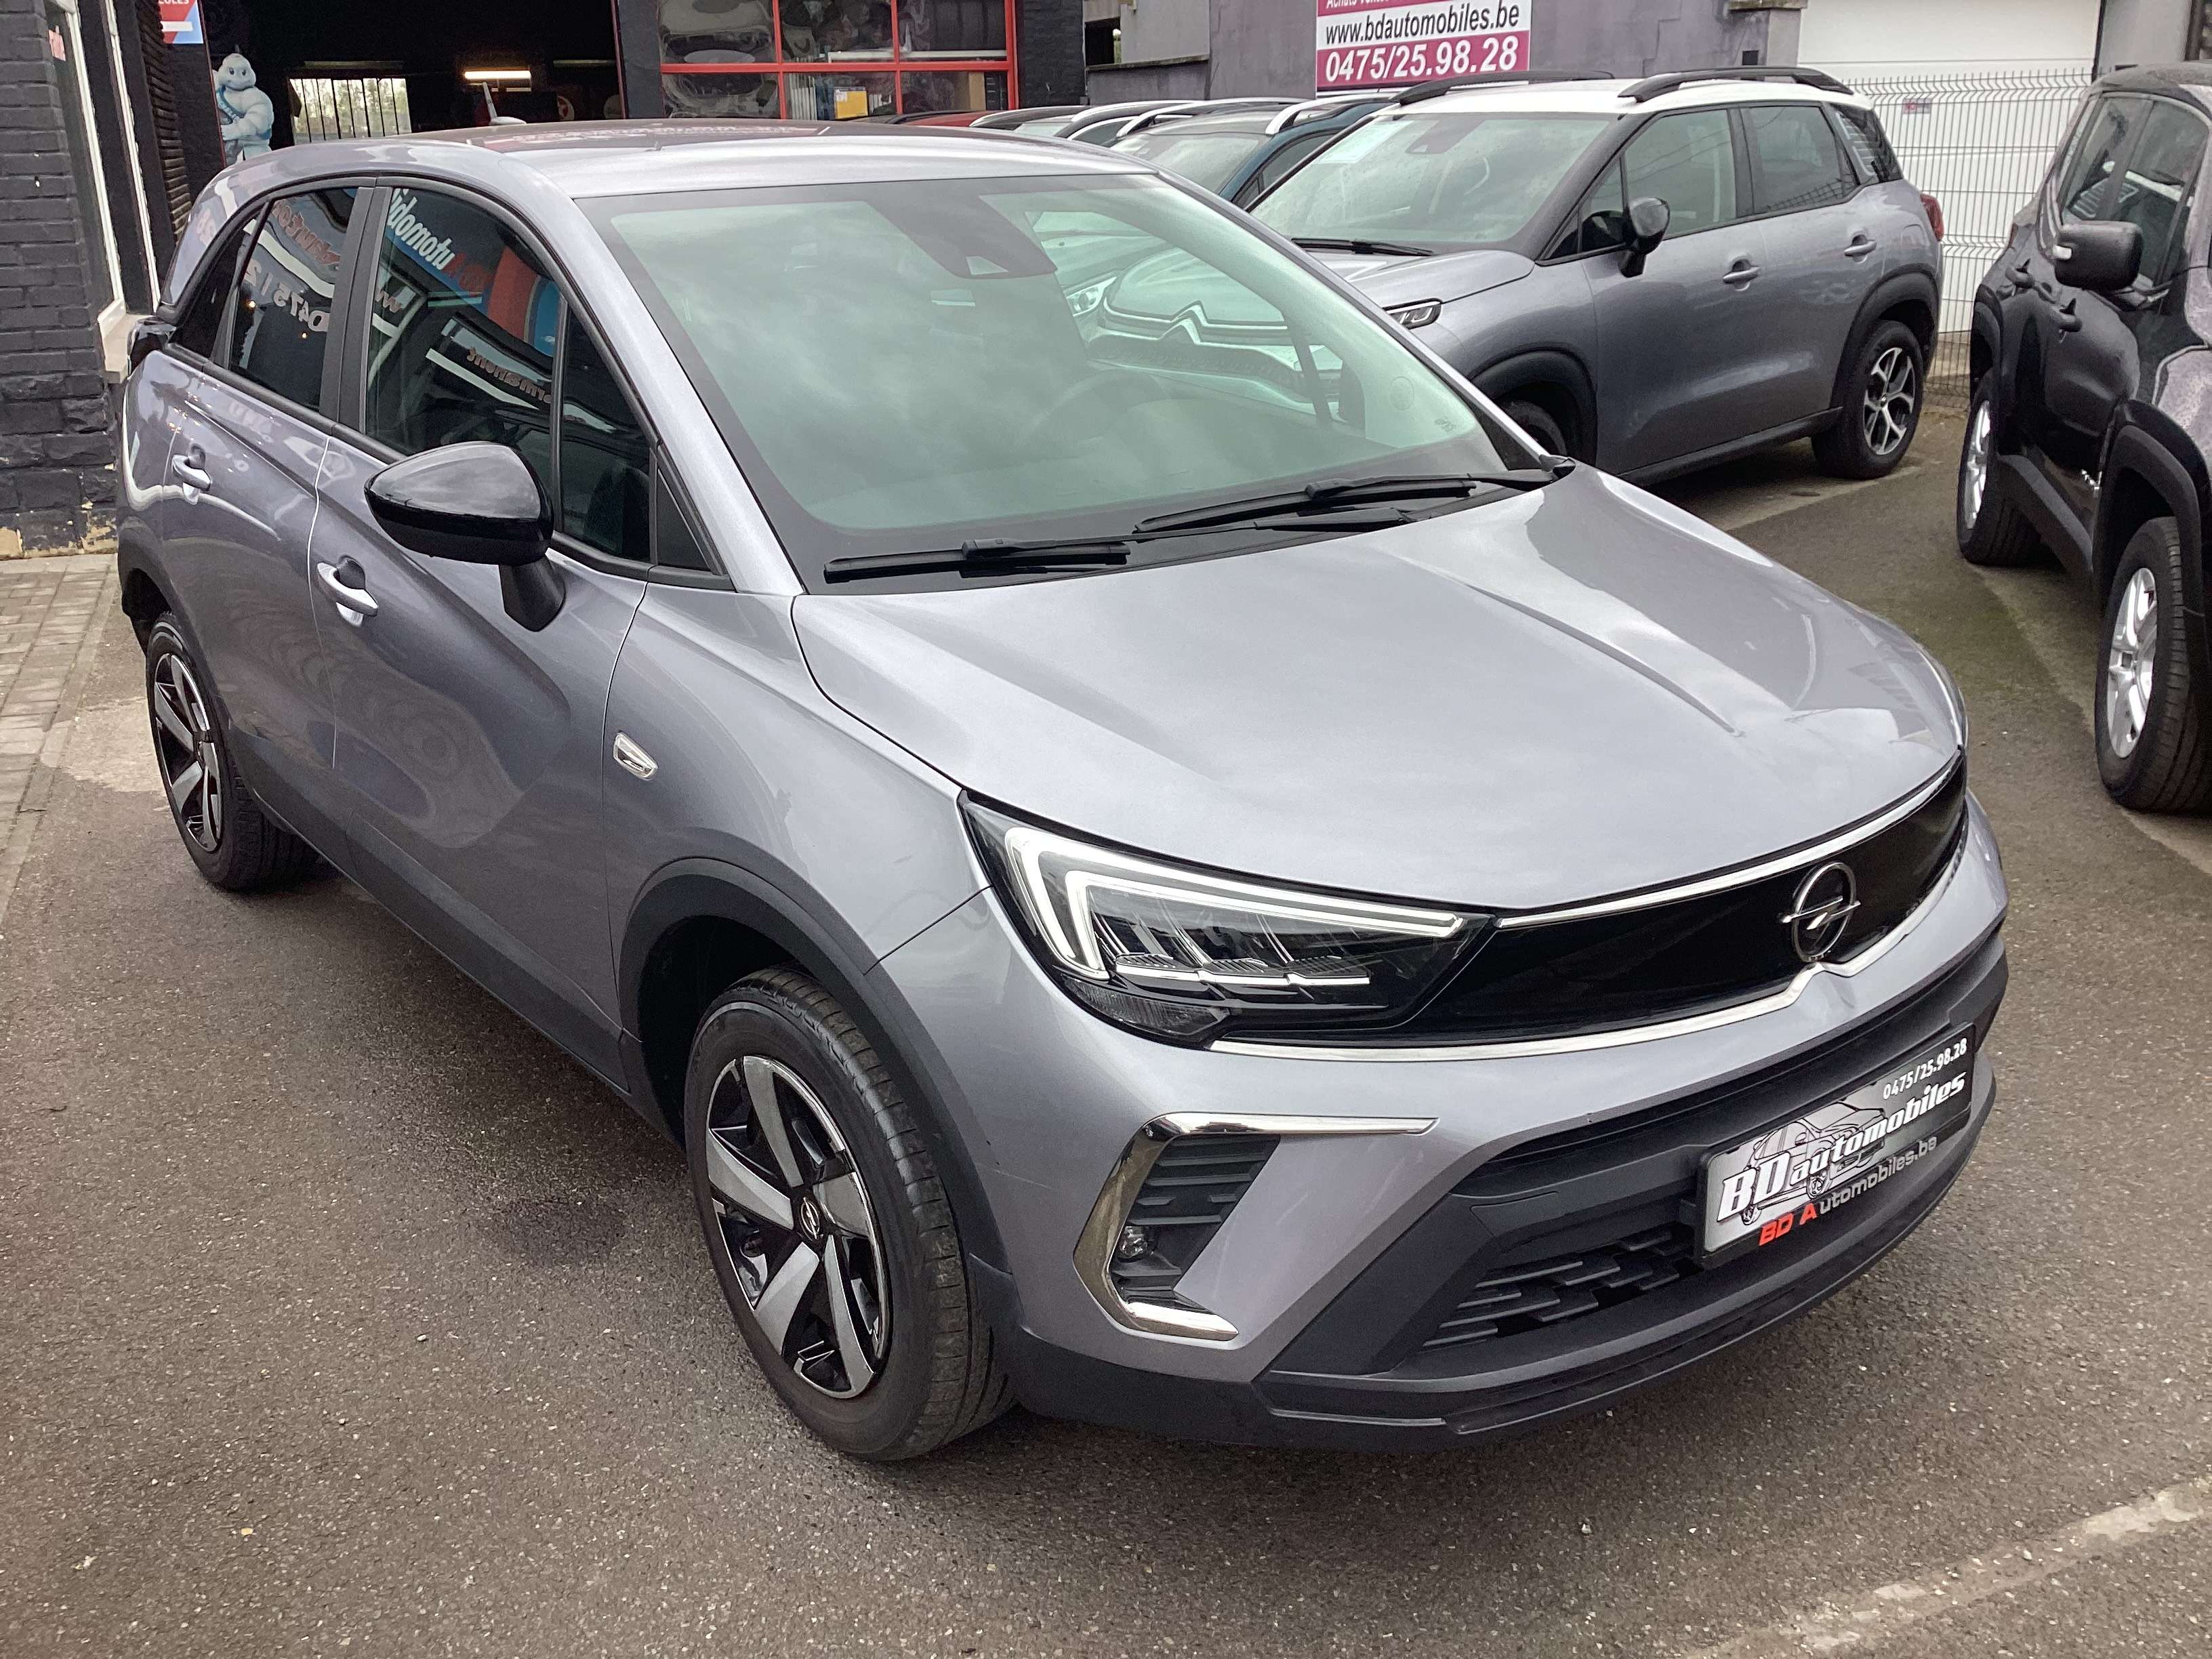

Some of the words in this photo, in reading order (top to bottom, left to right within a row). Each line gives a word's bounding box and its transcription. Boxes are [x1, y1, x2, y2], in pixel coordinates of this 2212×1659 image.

[1326, 0, 1519, 45] www.bdautomobiles.be
[1326, 35, 1519, 82] 0475/25.98.28
[1883, 1038, 1967, 1100] 0475/25.98.28
[1759, 1212, 1795, 1246] BD
